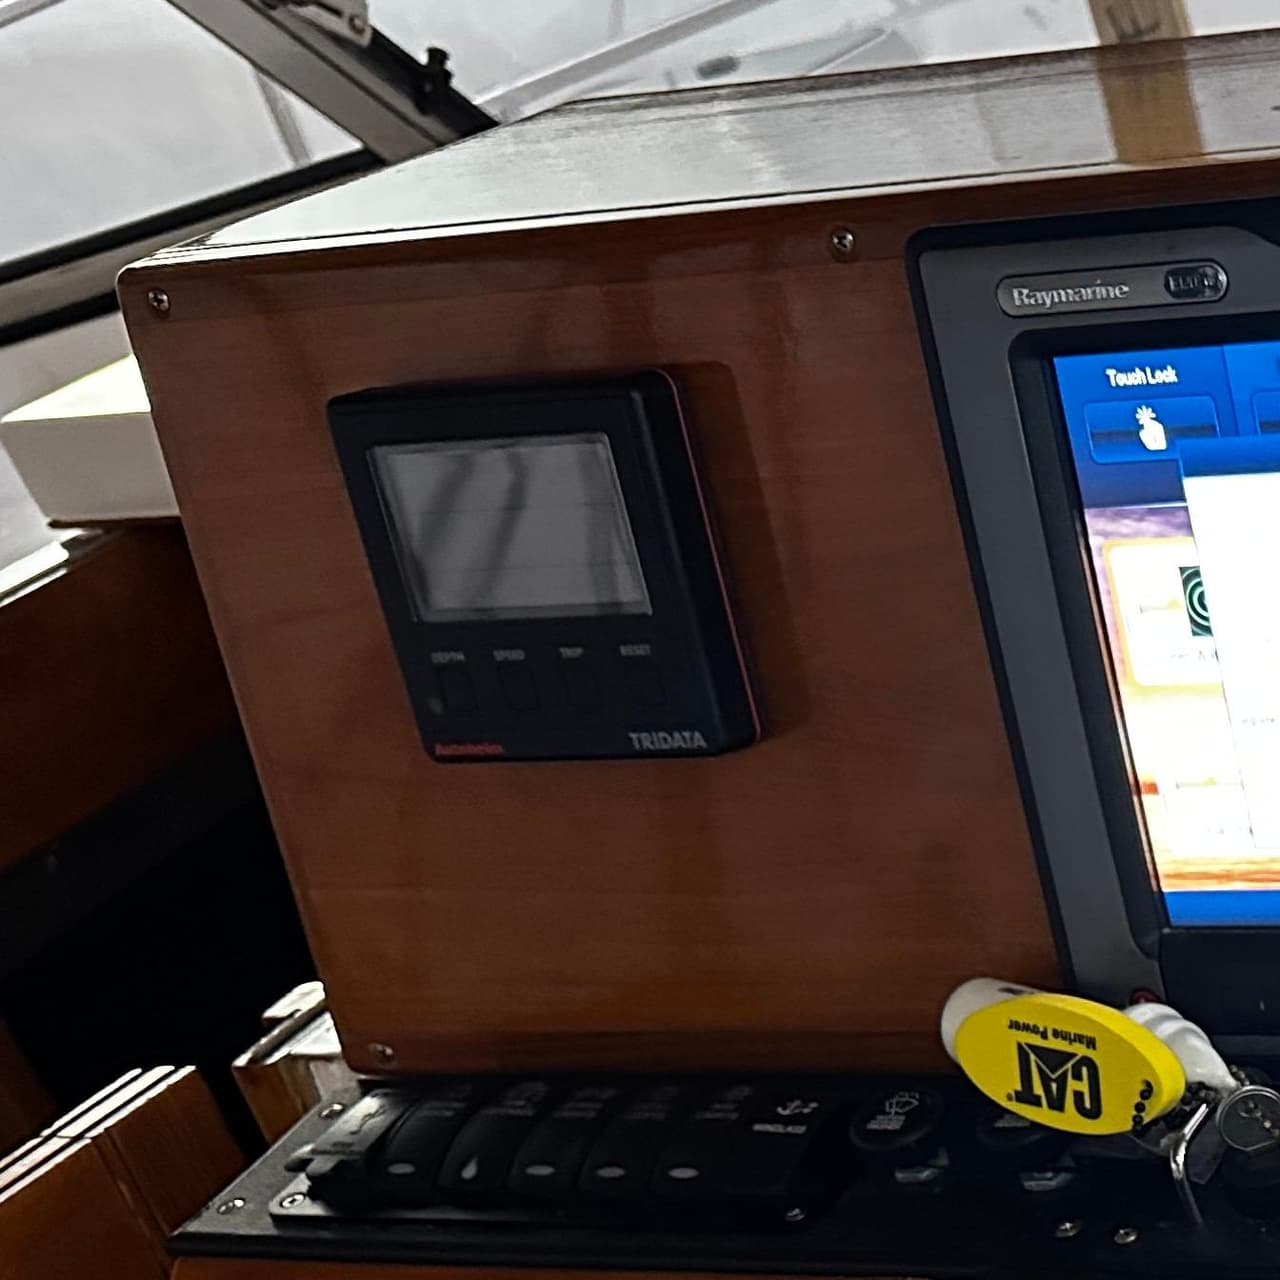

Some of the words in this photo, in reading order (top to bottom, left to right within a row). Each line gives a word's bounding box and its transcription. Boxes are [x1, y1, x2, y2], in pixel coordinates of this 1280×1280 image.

[1012, 281, 1130, 309] Raymarine
[1106, 367, 1147, 387] Touch
[1146, 365, 1178, 385] Lock
[629, 731, 707, 750] TRIDATA
[1008, 1019, 1049, 1041] Power
[1051, 1028, 1097, 1051] Marine
[1014, 1041, 1103, 1120] CAT
